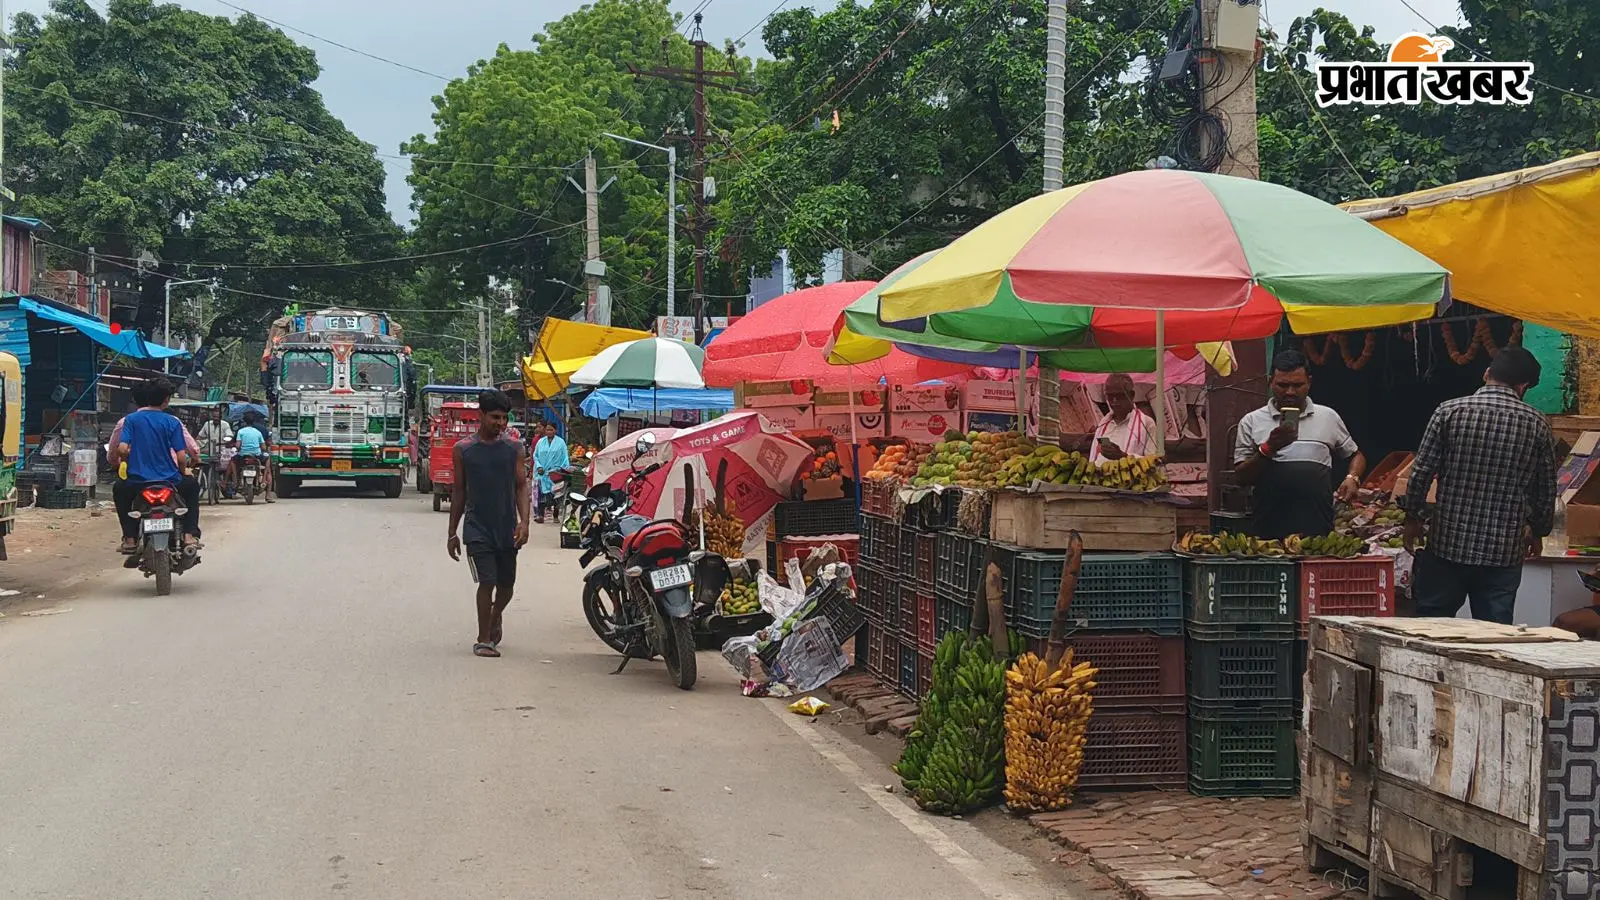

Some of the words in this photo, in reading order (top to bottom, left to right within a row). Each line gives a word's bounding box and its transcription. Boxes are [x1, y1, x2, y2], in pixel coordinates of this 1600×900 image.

[689, 438, 710, 448] TOYS
[712, 433, 719, 442] &
[611, 451, 637, 466] HOM
